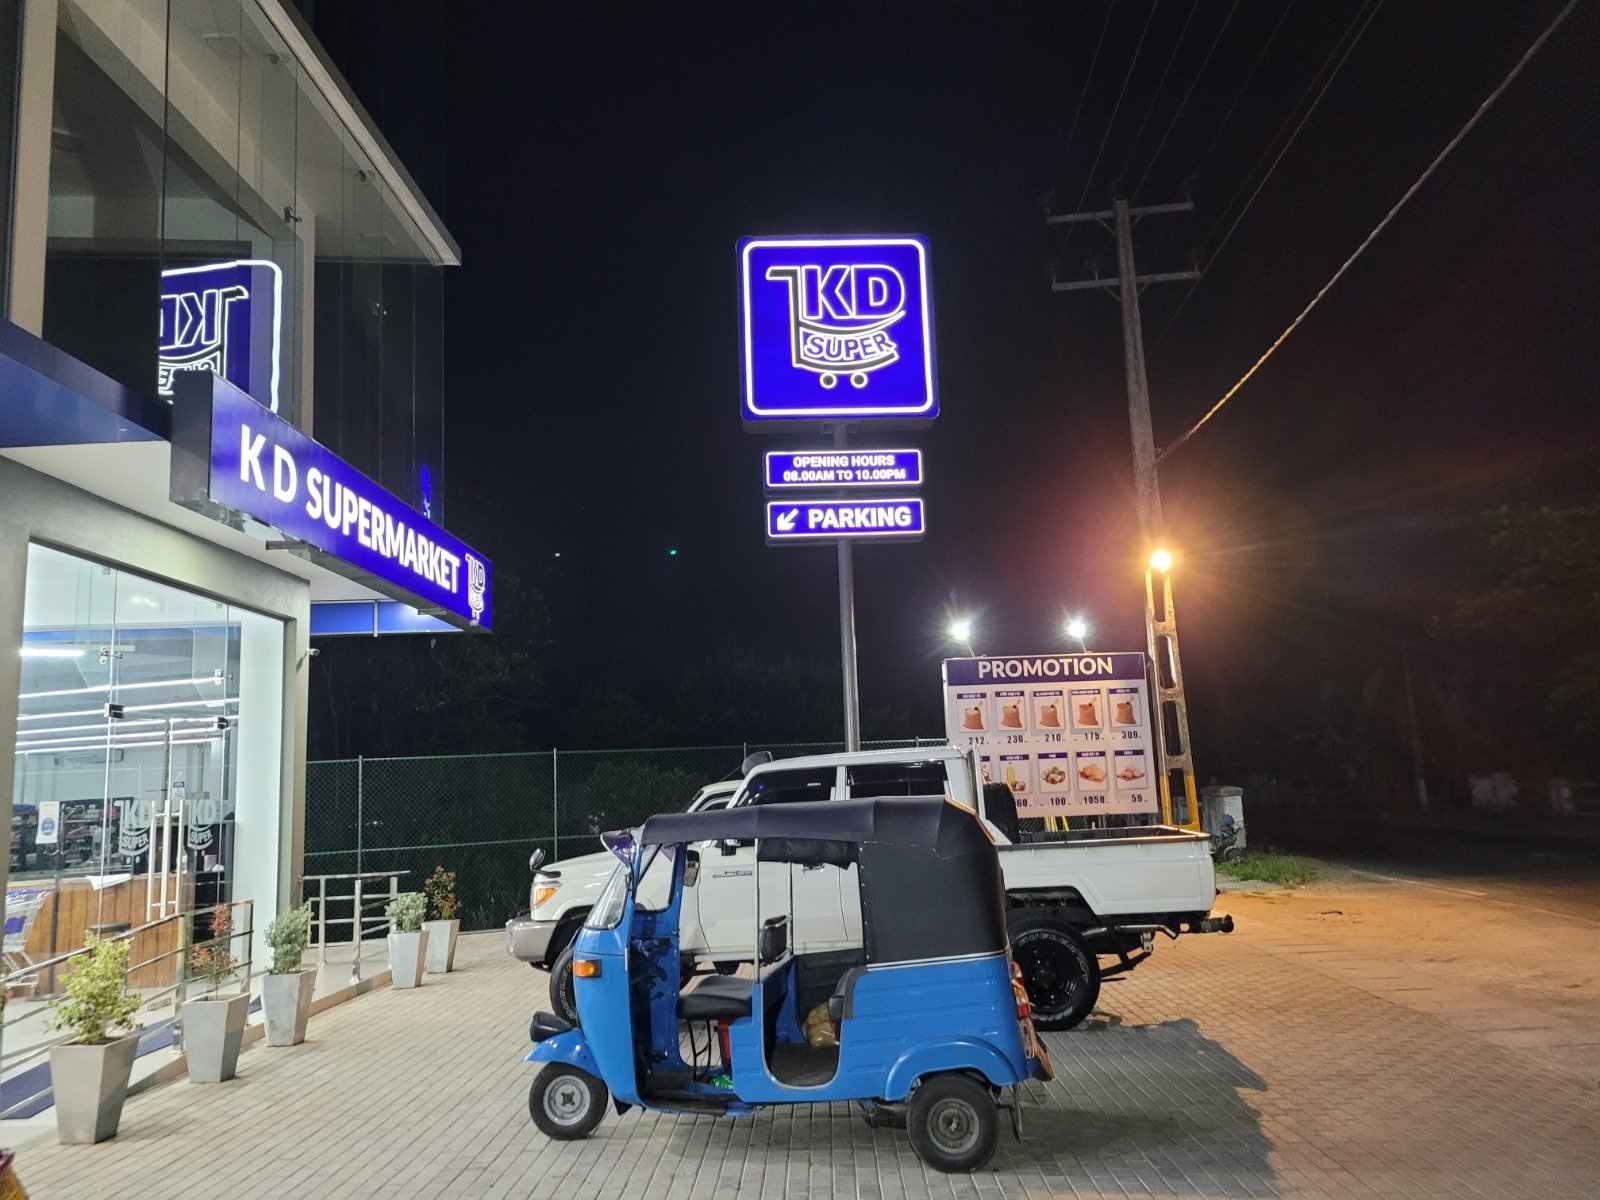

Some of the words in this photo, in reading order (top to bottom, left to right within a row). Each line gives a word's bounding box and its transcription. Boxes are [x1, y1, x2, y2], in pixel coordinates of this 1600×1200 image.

[801, 264, 905, 319] KD
[803, 331, 897, 361] SUPER
[792, 456, 849, 468] OPENING
[851, 455, 896, 467] HOURS
[782, 470, 835, 482] 08.00AM
[836, 470, 853, 481] TO
[855, 469, 906, 480] 10.00PM
[807, 506, 912, 529] PARKING
[305, 467, 461, 594] SUPERMARKET
[978, 657, 1113, 678] PROMOTION
[968, 736, 985, 745] 212
[1007, 735, 1024, 744] 230
[1044, 733, 1061, 742] 210
[1084, 732, 1100, 741] 175
[1121, 730, 1138, 740] 309
[1050, 797, 1066, 806] 100
[1083, 795, 1105, 804] 1050
[1131, 794, 1143, 803] 59
[121, 835, 149, 850] SUPER
[190, 830, 212, 844] SUPER
